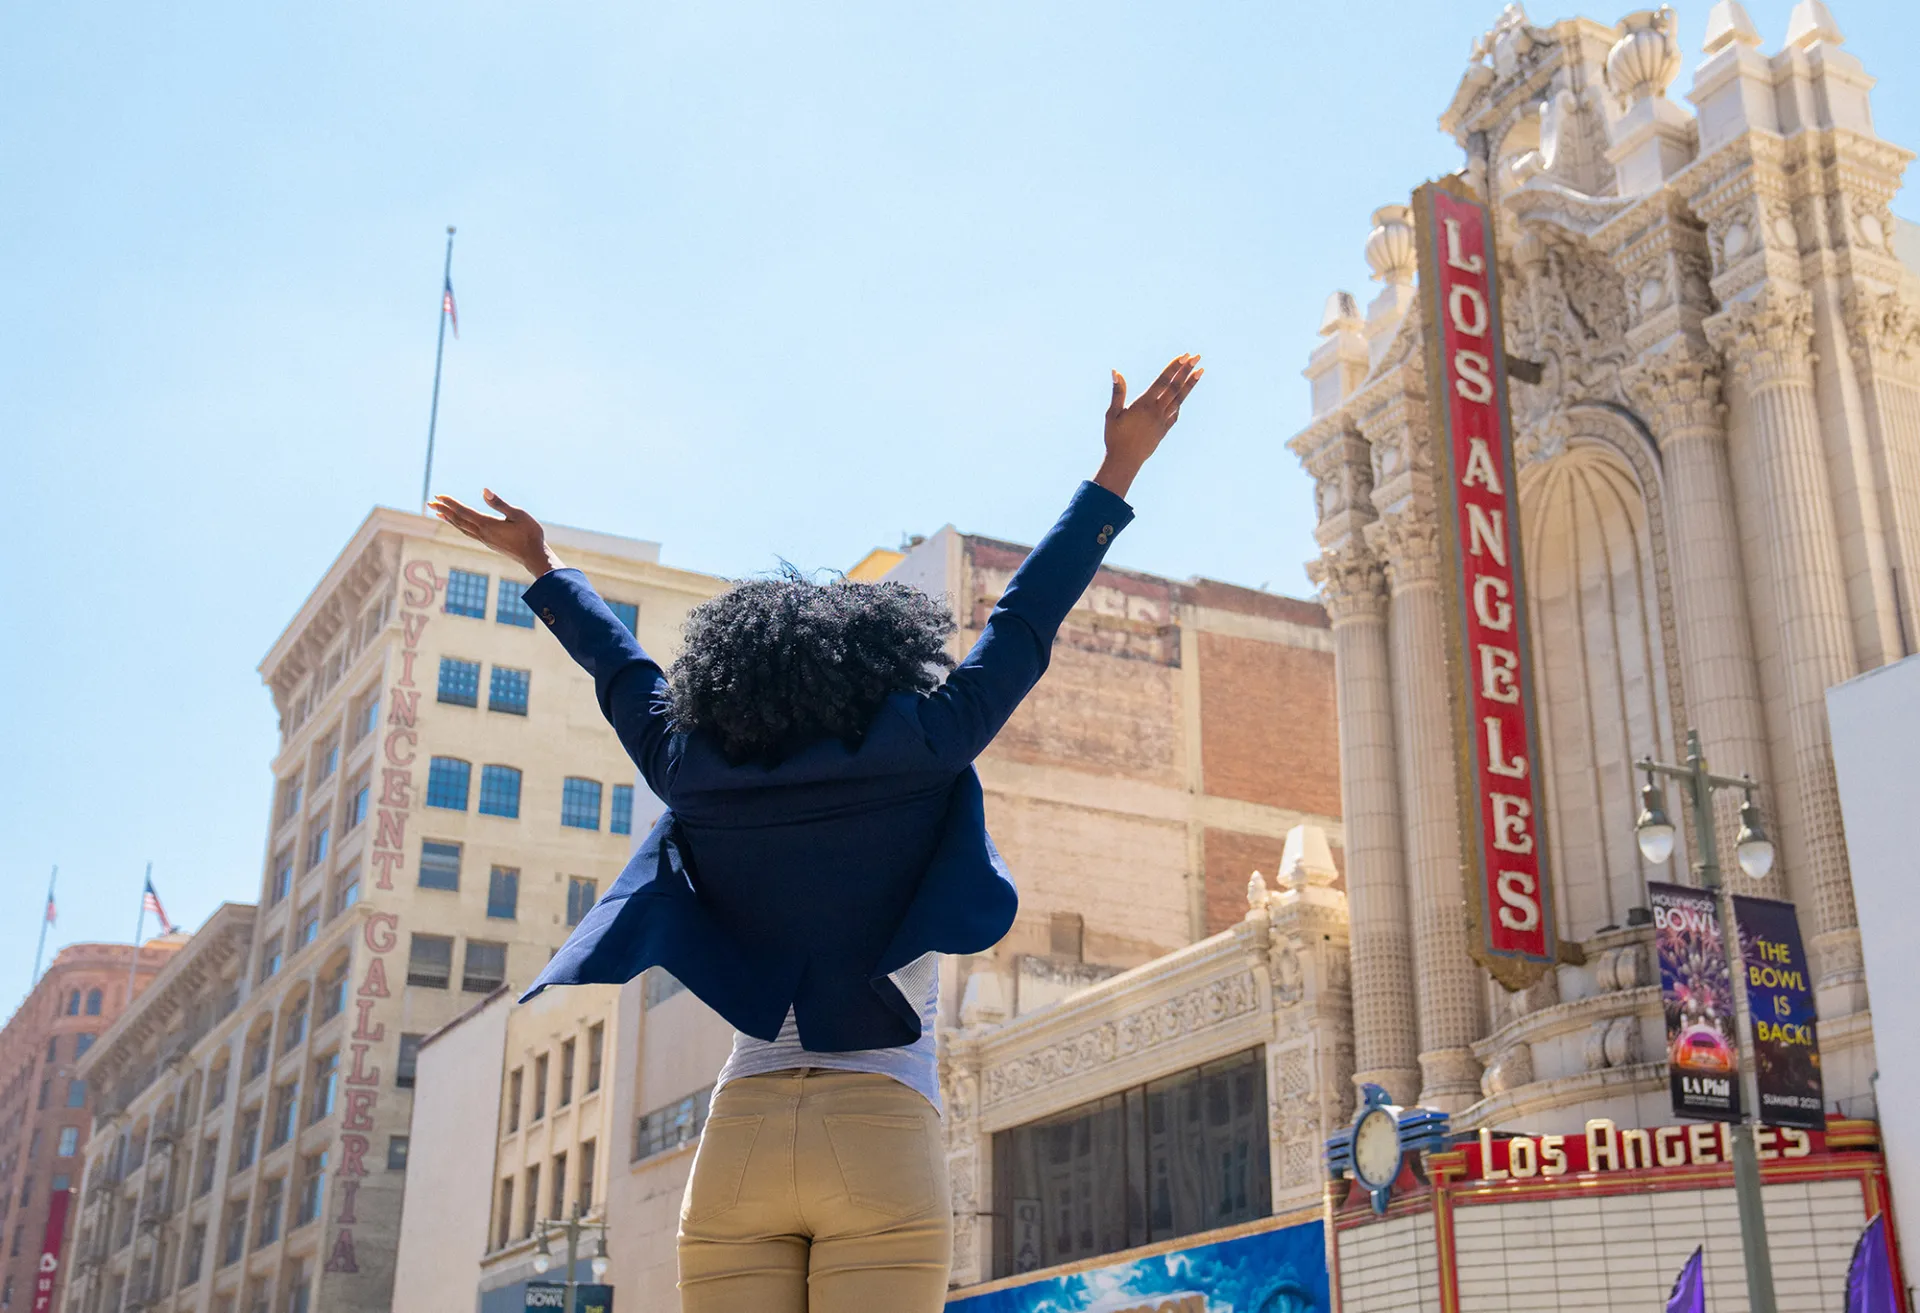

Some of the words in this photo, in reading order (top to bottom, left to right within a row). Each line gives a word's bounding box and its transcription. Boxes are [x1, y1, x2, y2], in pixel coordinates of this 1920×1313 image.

[1444, 217, 1493, 405] LOS
[1462, 436, 1540, 932] ANGELES
[372, 611, 430, 891] VINCENT
[1653, 905, 1721, 937] BOWL
[1757, 940, 1791, 964] THE
[1749, 966, 1806, 991] BOWL
[1773, 995, 1791, 1016] IS
[1757, 1021, 1812, 1046] BACK!
[324, 912, 398, 1273] GALLERIA
[1682, 1076, 1701, 1094] LA
[1702, 1077, 1730, 1097] Phil
[526, 1292, 564, 1307] BOWL
